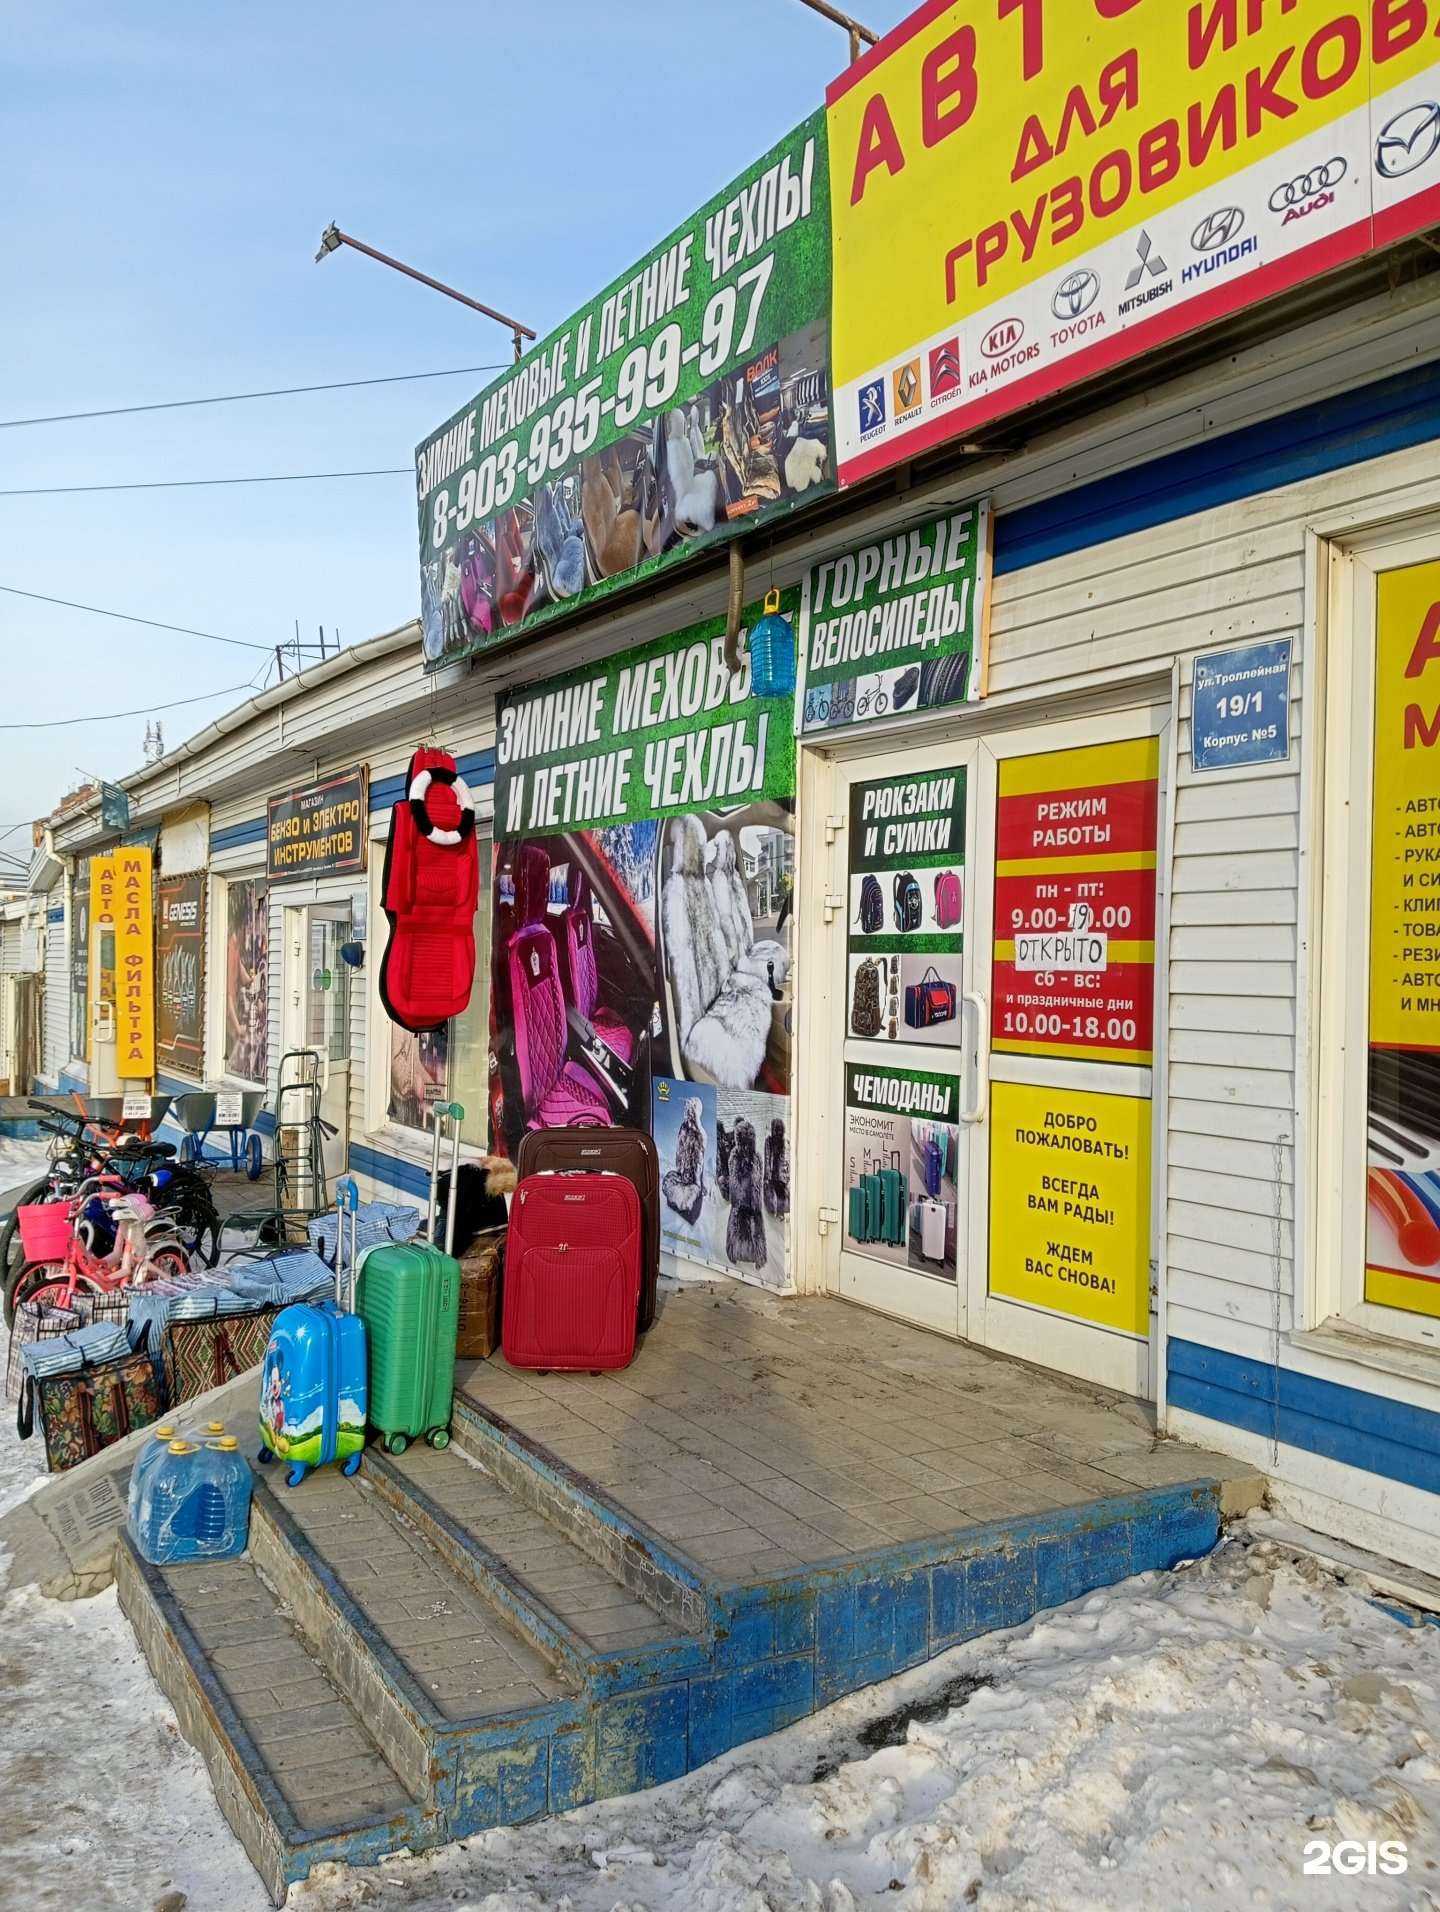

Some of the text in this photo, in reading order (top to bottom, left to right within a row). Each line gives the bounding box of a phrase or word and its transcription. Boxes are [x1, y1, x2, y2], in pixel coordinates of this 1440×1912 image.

[850, 0, 1140, 206] АВТ
[1010, 48, 1138, 183] ДЛЯ
[945, 0, 1440, 304] ГРУЗОВИКОВ
[1181, 236, 1258, 284] HYUNDAI
[1118, 280, 1173, 317] MITSUBISH
[417, 137, 815, 501] ЗИМНИЕ МЕХОВЫЕ И ЛЕТНИЕ ЧЕХЛЫ
[1050, 311, 1106, 348] TOYOTA
[988, 325, 1017, 352] KIA
[968, 343, 1041, 389] KIA MOTORS
[432, 254, 775, 549] 8-903-935-99-97
[894, 407, 923, 427] RENAULT
[860, 424, 887, 443] PEUGEOT
[814, 510, 976, 615] ГОРНЫЕ
[809, 577, 970, 672] ВЕЛОСИПЕДЫ
[498, 676, 609, 765] ЗИМНИЕ
[1216, 691, 1263, 719] 19/1
[1203, 725, 1277, 748] Корпус №5
[506, 713, 769, 834] И ЛЕТНИЕ ЧЕХЛЫ
[301, 794, 324, 810] МАГАЗИН
[863, 778, 956, 820] РЮКЗАКИ
[1037, 798, 1107, 821] РЕЖИМ
[1405, 798, 1440, 813] АВТ
[271, 817, 300, 841] БЕНЗО
[313, 800, 359, 832] ЭЛЕКТРО
[1033, 824, 1111, 847] РАБОТЫ
[1405, 822, 1440, 838] АВТ
[274, 831, 353, 866] ИНСТРУМЕНТОВ
[864, 817, 952, 857] И СУМКИ
[99, 869, 114, 923] АВТО
[1036, 884, 1058, 898] пн
[1077, 882, 1104, 898] пт:
[1403, 874, 1413, 887] И
[123, 860, 142, 936] МАСЛА
[1020, 936, 1103, 963] ОТКРЫТО
[1035, 970, 1055, 986] сб
[1074, 974, 1101, 989] вс:
[124, 954, 144, 1060] ФИЛЬТРА
[1006, 992, 1134, 1012] и праздничные дни
[1401, 998, 1411, 1011] И
[1003, 1012, 1137, 1042] 10.00-18.00
[853, 1074, 951, 1115] ЧЕМОДАНЫ
[850, 1115, 895, 1131] ЭКОНОМИТ
[1044, 1111, 1098, 1132] ДОБРО
[1015, 1129, 1129, 1160] ПОЖАЛОВАТЬ!
[1042, 1175, 1100, 1200] ВСЕГДА
[1027, 1195, 1115, 1226] ВАМ РАДЫ!
[1046, 1241, 1093, 1265] ЖДЕМ
[1025, 1258, 1117, 1294] ВАС СНОВА!
